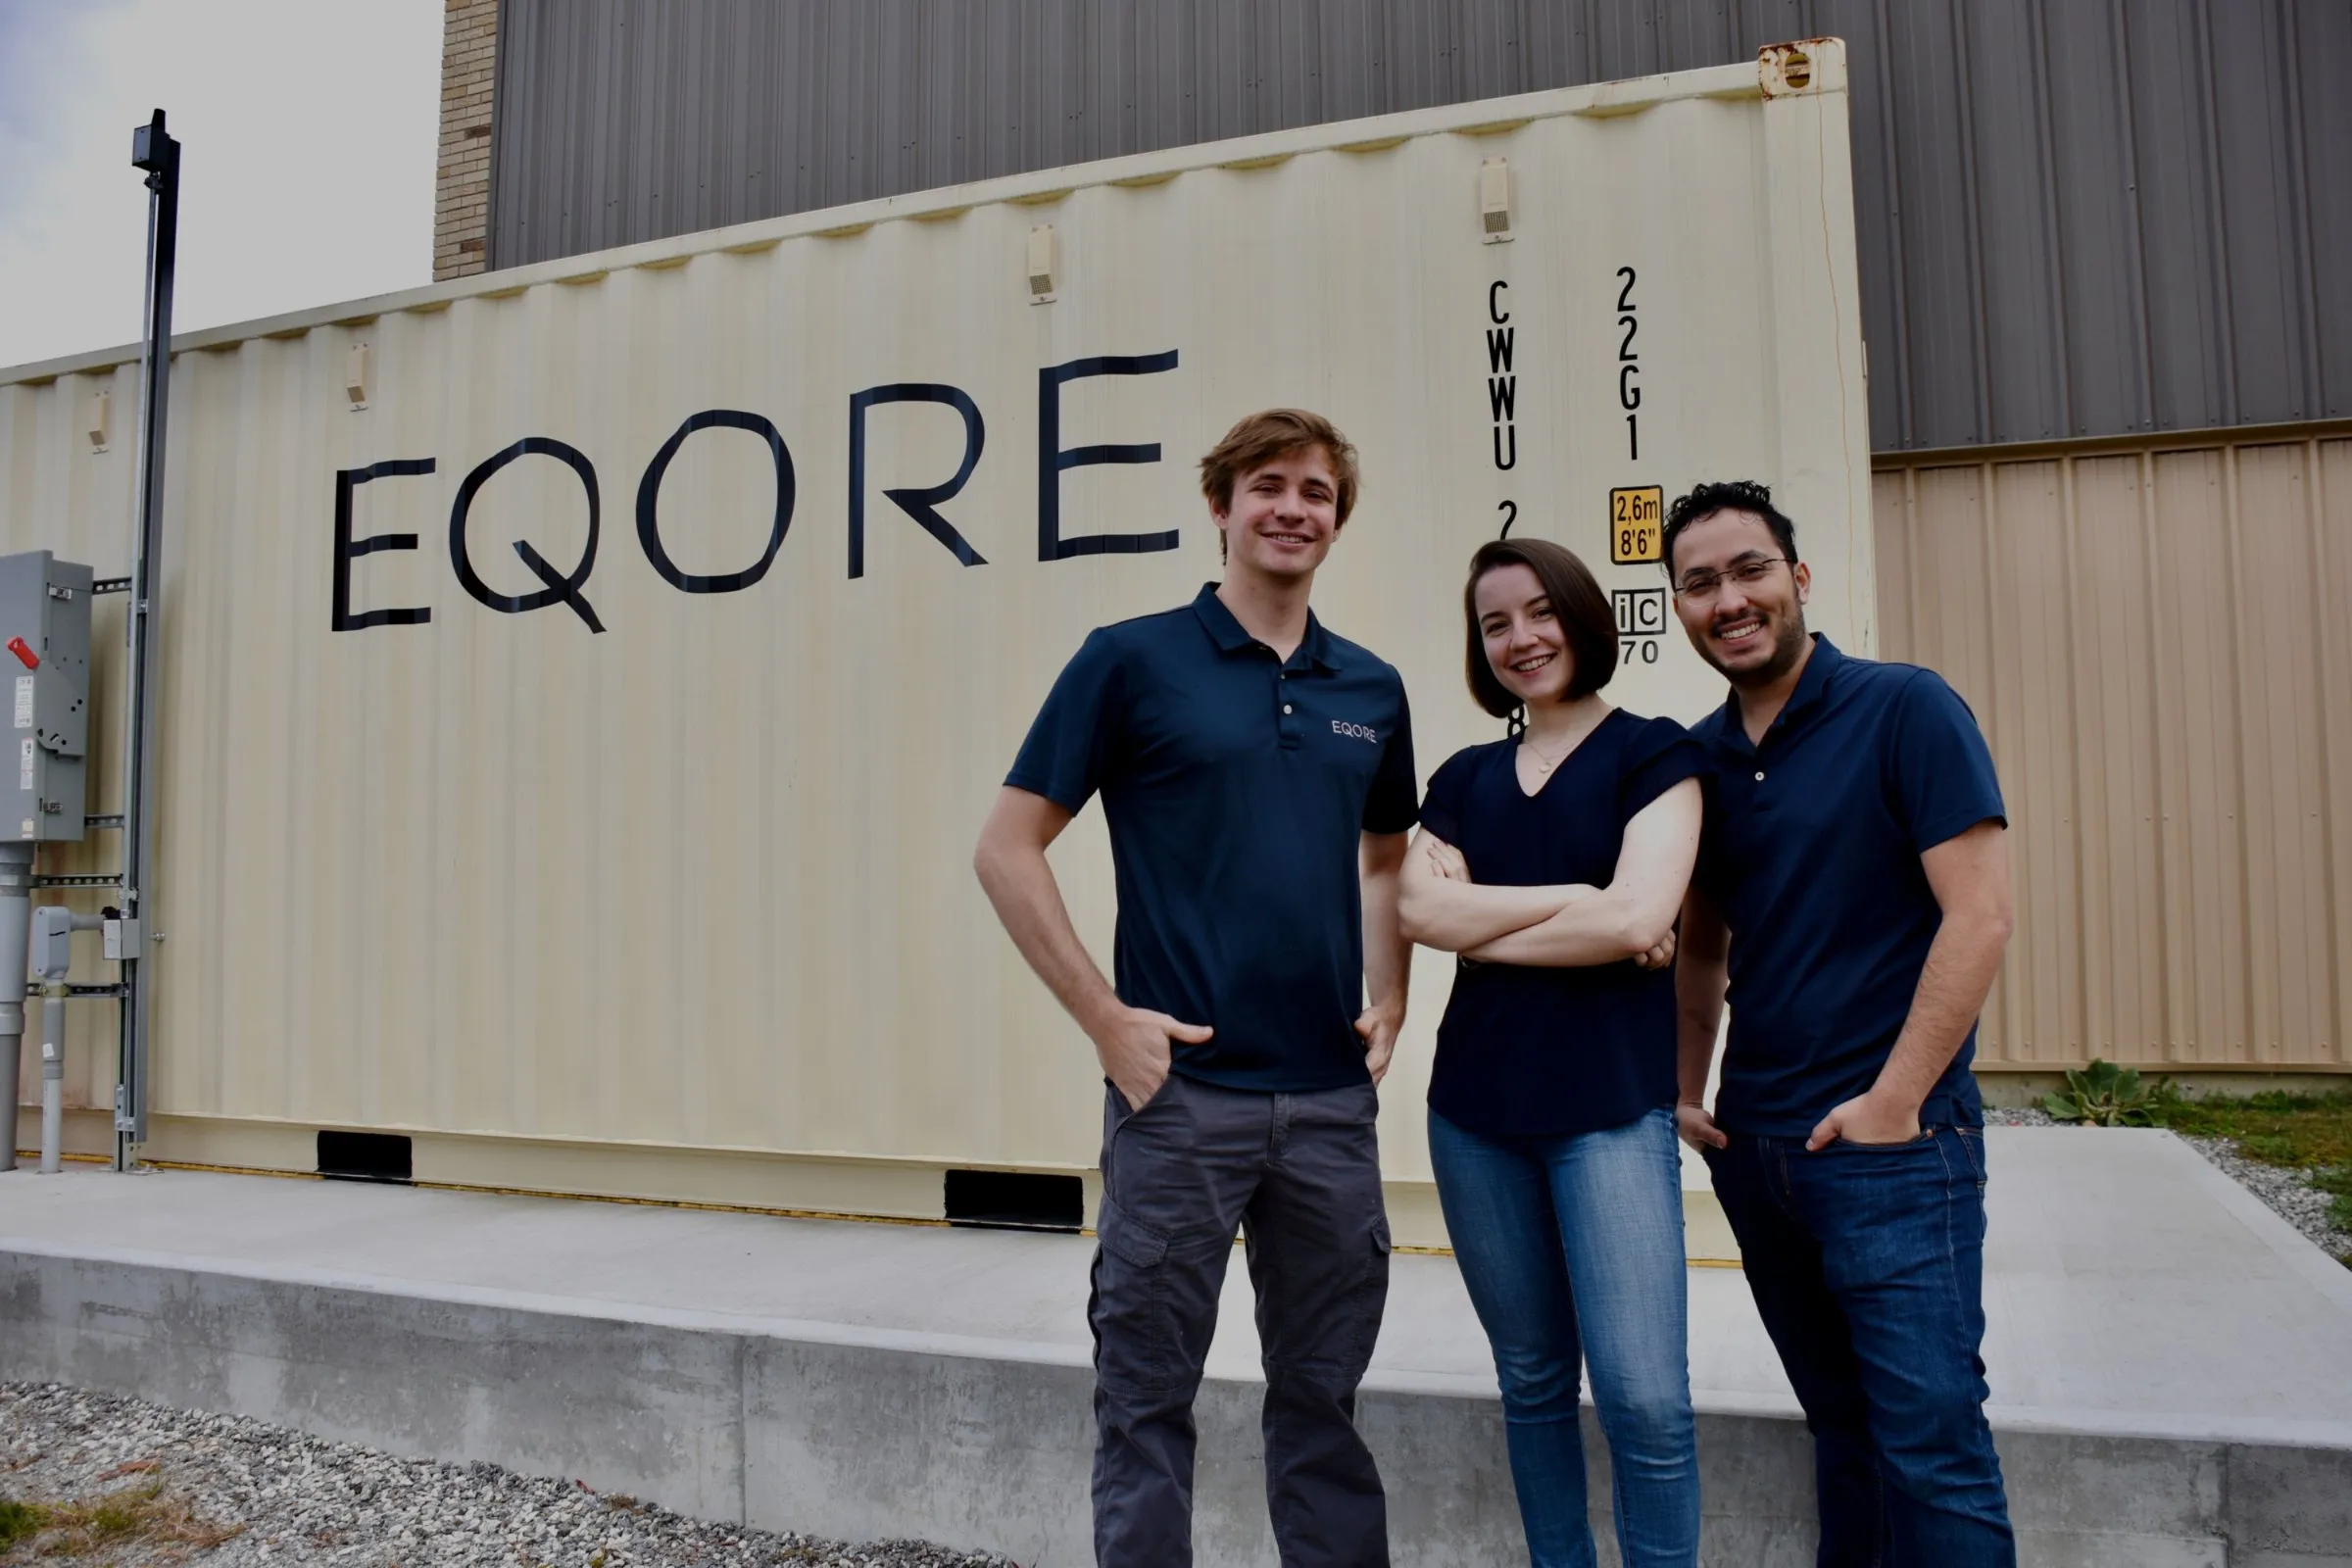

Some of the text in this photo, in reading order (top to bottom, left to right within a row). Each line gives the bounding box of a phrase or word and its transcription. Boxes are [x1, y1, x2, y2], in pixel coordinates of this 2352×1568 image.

[1487, 281, 1516, 470] CWWU
[1617, 267, 1641, 460] 22G1
[332, 349, 1179, 634] EQORE
[1617, 495, 1658, 525] 2,6m
[1620, 640, 1659, 664] 70
[1332, 720, 1377, 744] EQORE
